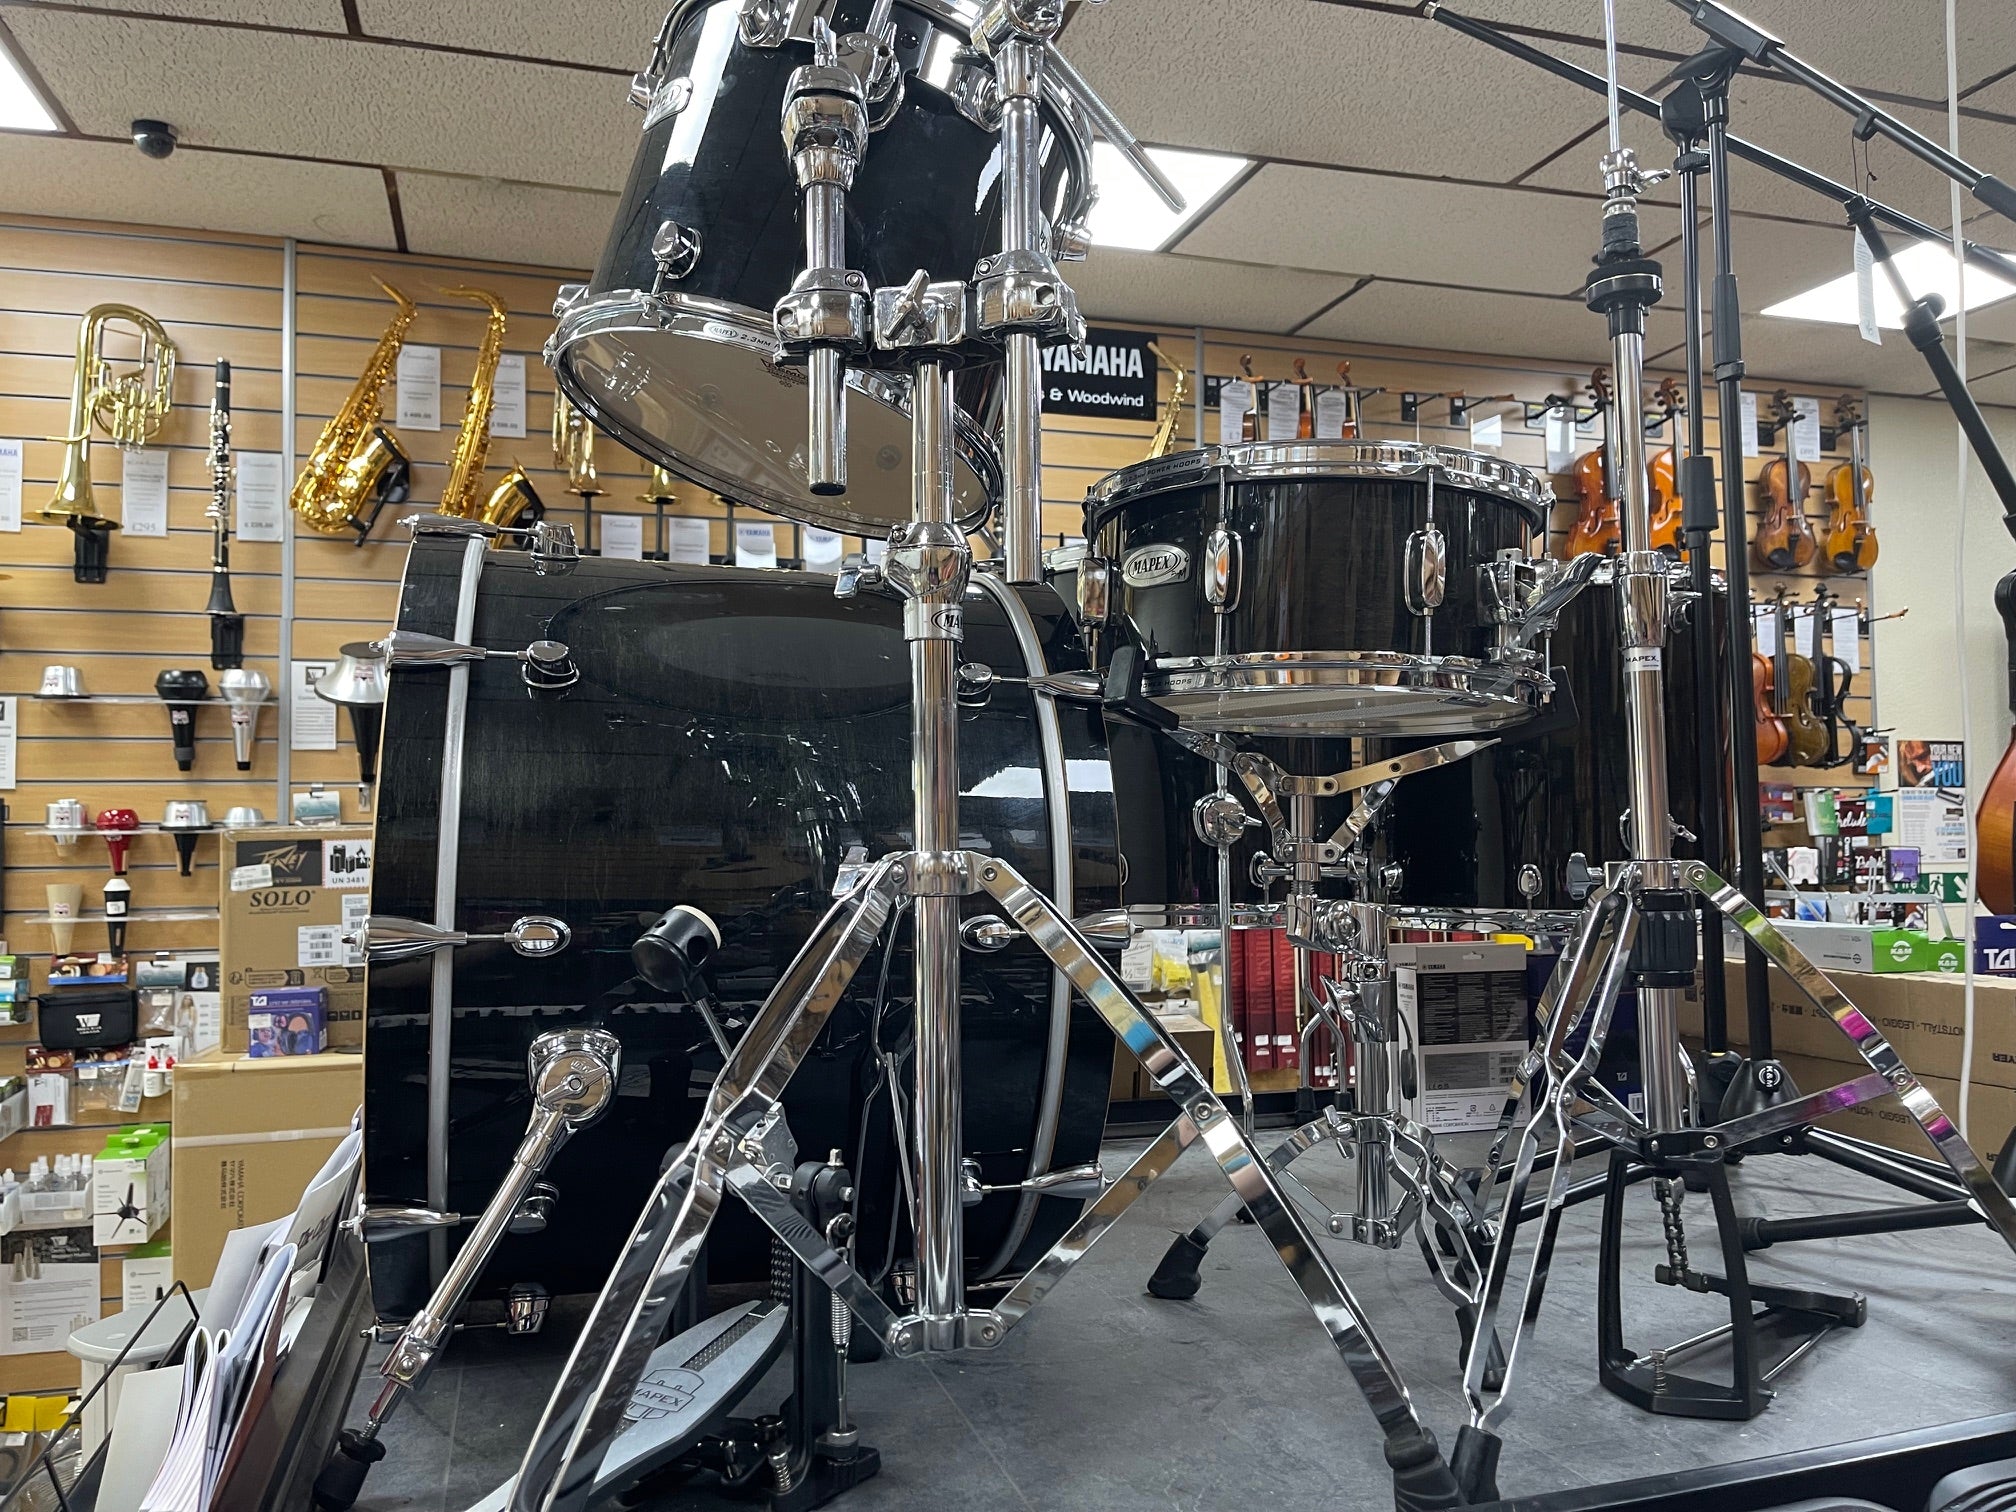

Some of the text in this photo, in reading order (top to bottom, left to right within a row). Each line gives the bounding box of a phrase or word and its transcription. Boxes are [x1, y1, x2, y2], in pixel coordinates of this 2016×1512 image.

[740, 333, 771, 347] 2.3MM
[1042, 344, 1144, 378] YAMAHA
[1050, 387, 1063, 401] &
[1067, 389, 1144, 407] Woodwind
[1148, 465, 1171, 476] POWER
[1173, 459, 1201, 469] HOOPS
[1132, 555, 1172, 576] MAPEX
[1625, 655, 1657, 663] MAPEX
[1165, 678, 1192, 686] HOOPS
[1932, 761, 1963, 787] YOU
[346, 876, 365, 884] 3481
[250, 890, 311, 908] SOLO
[1890, 947, 1913, 955] K&M
[1883, 1017, 1915, 1030] LEGGIO
[1766, 1065, 1774, 1087] K&M
[1879, 1110, 1911, 1124] LEGGIO
[237, 1159, 245, 1188] YAMAHA
[634, 1388, 684, 1407] MAPEX
